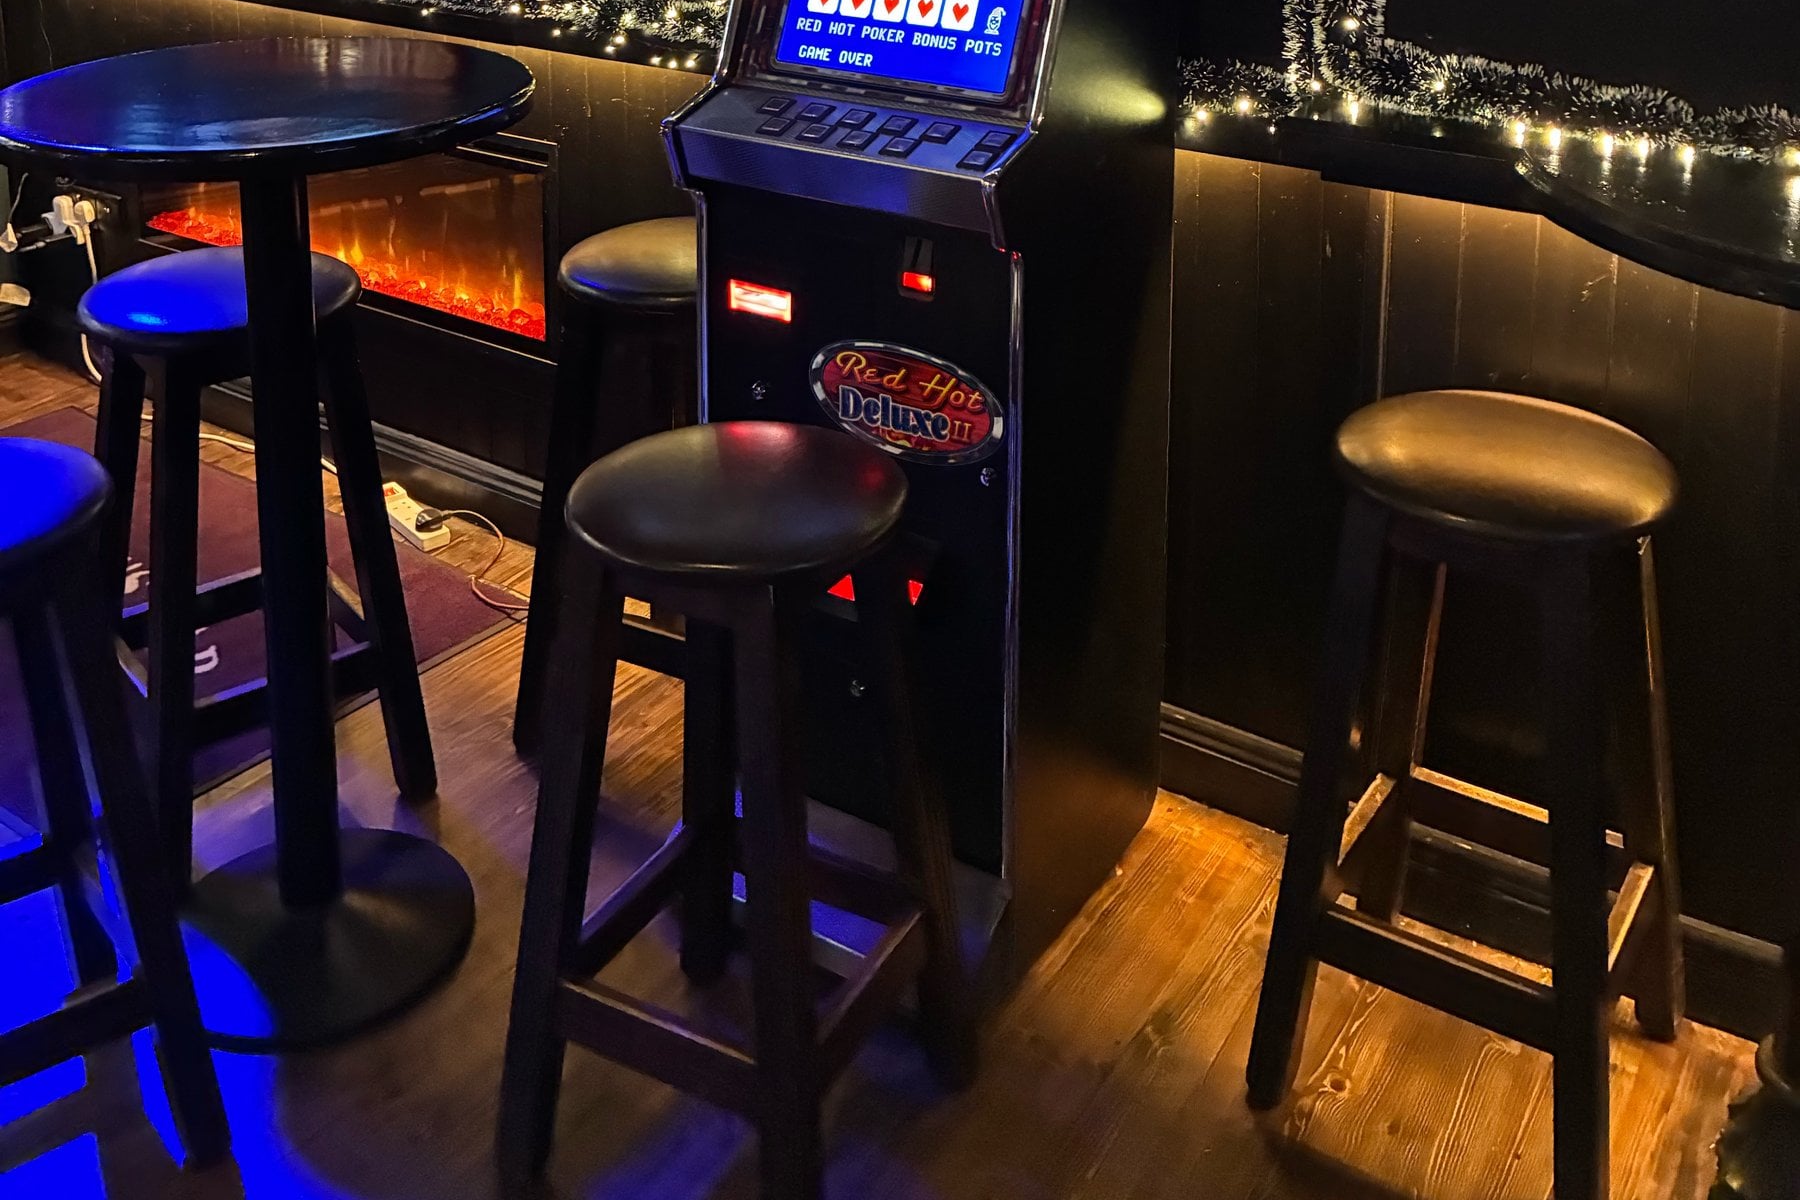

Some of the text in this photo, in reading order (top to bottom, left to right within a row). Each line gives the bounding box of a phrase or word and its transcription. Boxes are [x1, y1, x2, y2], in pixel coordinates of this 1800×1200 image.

[796, 17, 1003, 57] RED HOT POKER BONUS POTS
[798, 44, 874, 68] GAME OVER
[835, 351, 985, 410] Red Hot
[838, 384, 972, 443] Deluxe II
